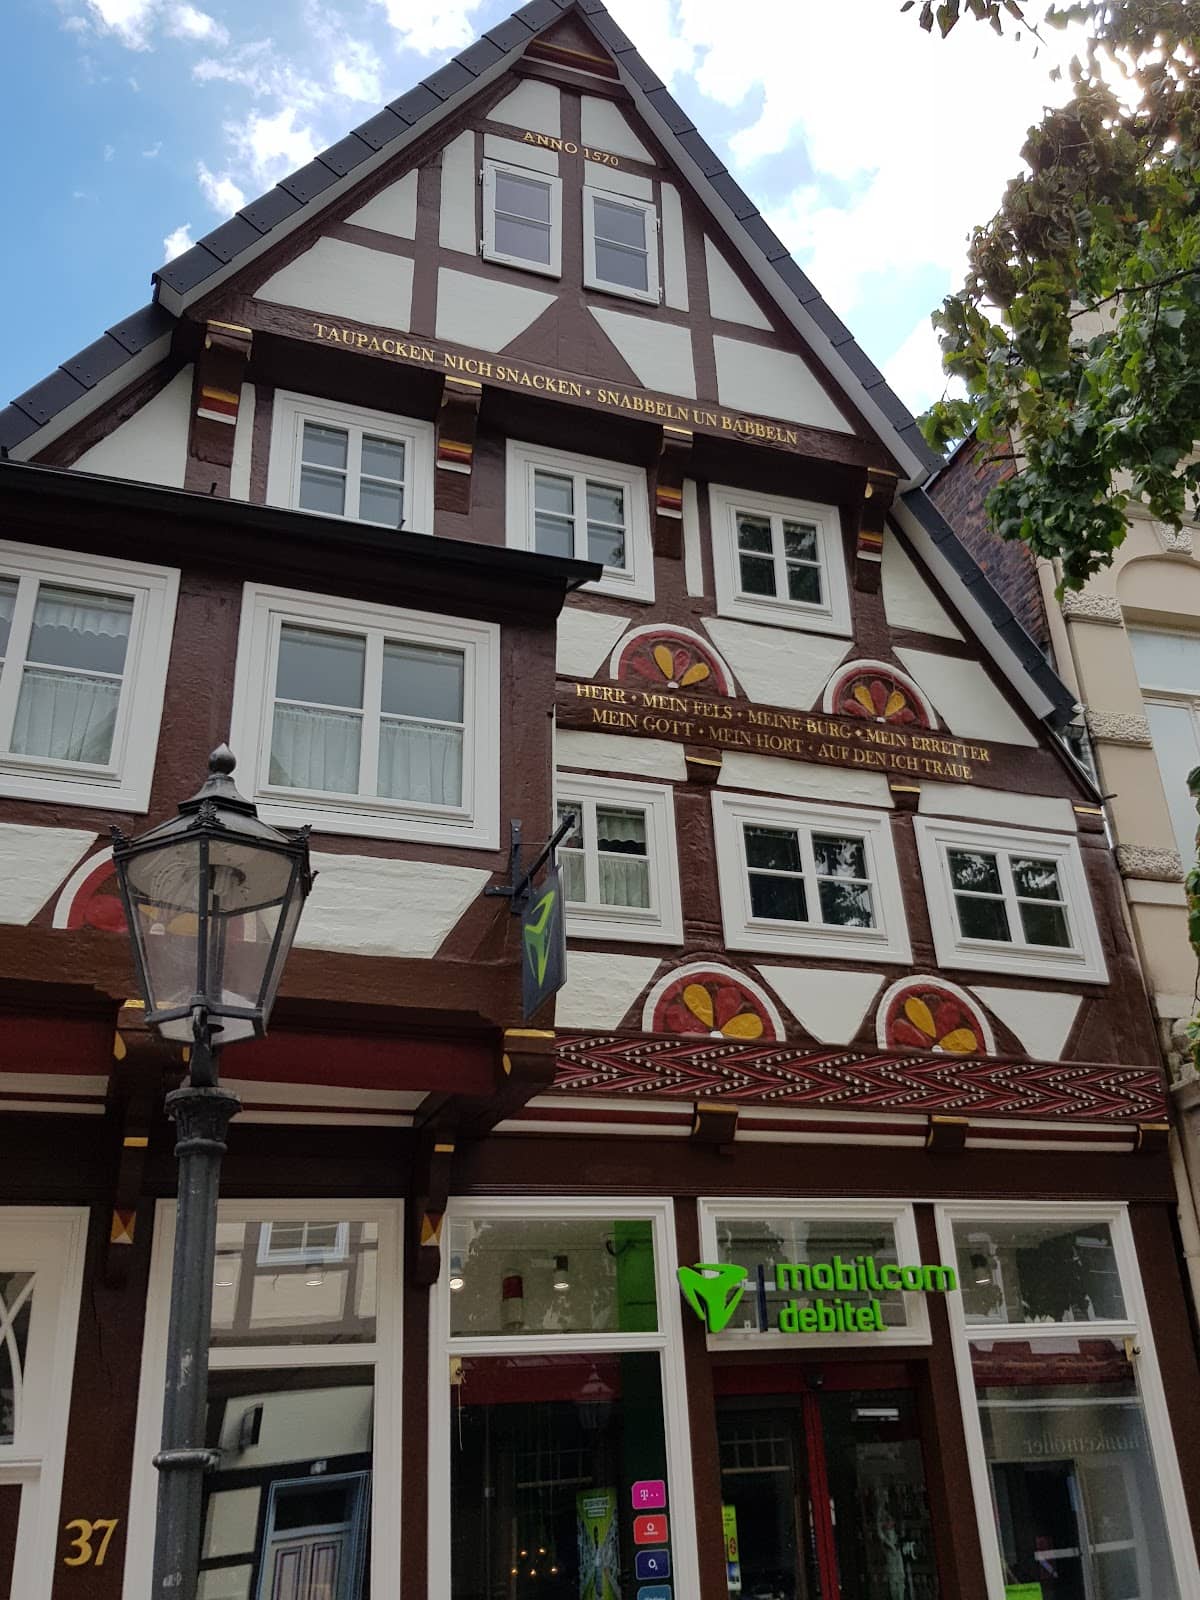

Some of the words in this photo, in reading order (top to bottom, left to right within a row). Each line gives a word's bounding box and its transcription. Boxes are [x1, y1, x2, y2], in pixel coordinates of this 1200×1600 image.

[523, 131, 577, 154] ANNO
[583, 148, 619, 166] 1570
[313, 322, 435, 363] TAUPACKEN
[443, 353, 492, 377] NICH
[496, 366, 582, 397] SNACKEN
[597, 389, 689, 421] SNABBELN
[692, 410, 717, 427] UN
[721, 416, 798, 445] BABBELN
[575, 683, 626, 704] HERR
[642, 693, 688, 713] MEIN
[694, 702, 733, 720] FELS
[747, 709, 803, 731] MEINE
[806, 719, 852, 738] BURG
[865, 728, 906, 747] MEIN
[911, 736, 990, 762] ERRETTER
[592, 707, 639, 729] MEIN
[643, 715, 695, 737] GOTT
[709, 726, 751, 746] MEIN
[756, 733, 804, 753] HORT
[818, 743, 850, 760] AUF
[852, 748, 887, 766] DEN
[890, 753, 919, 770] ICH
[921, 758, 974, 780] TRAUE
[774, 1255, 957, 1291] mobilcom
[778, 1298, 889, 1333] debitel
[64, 1518, 119, 1567] 37
